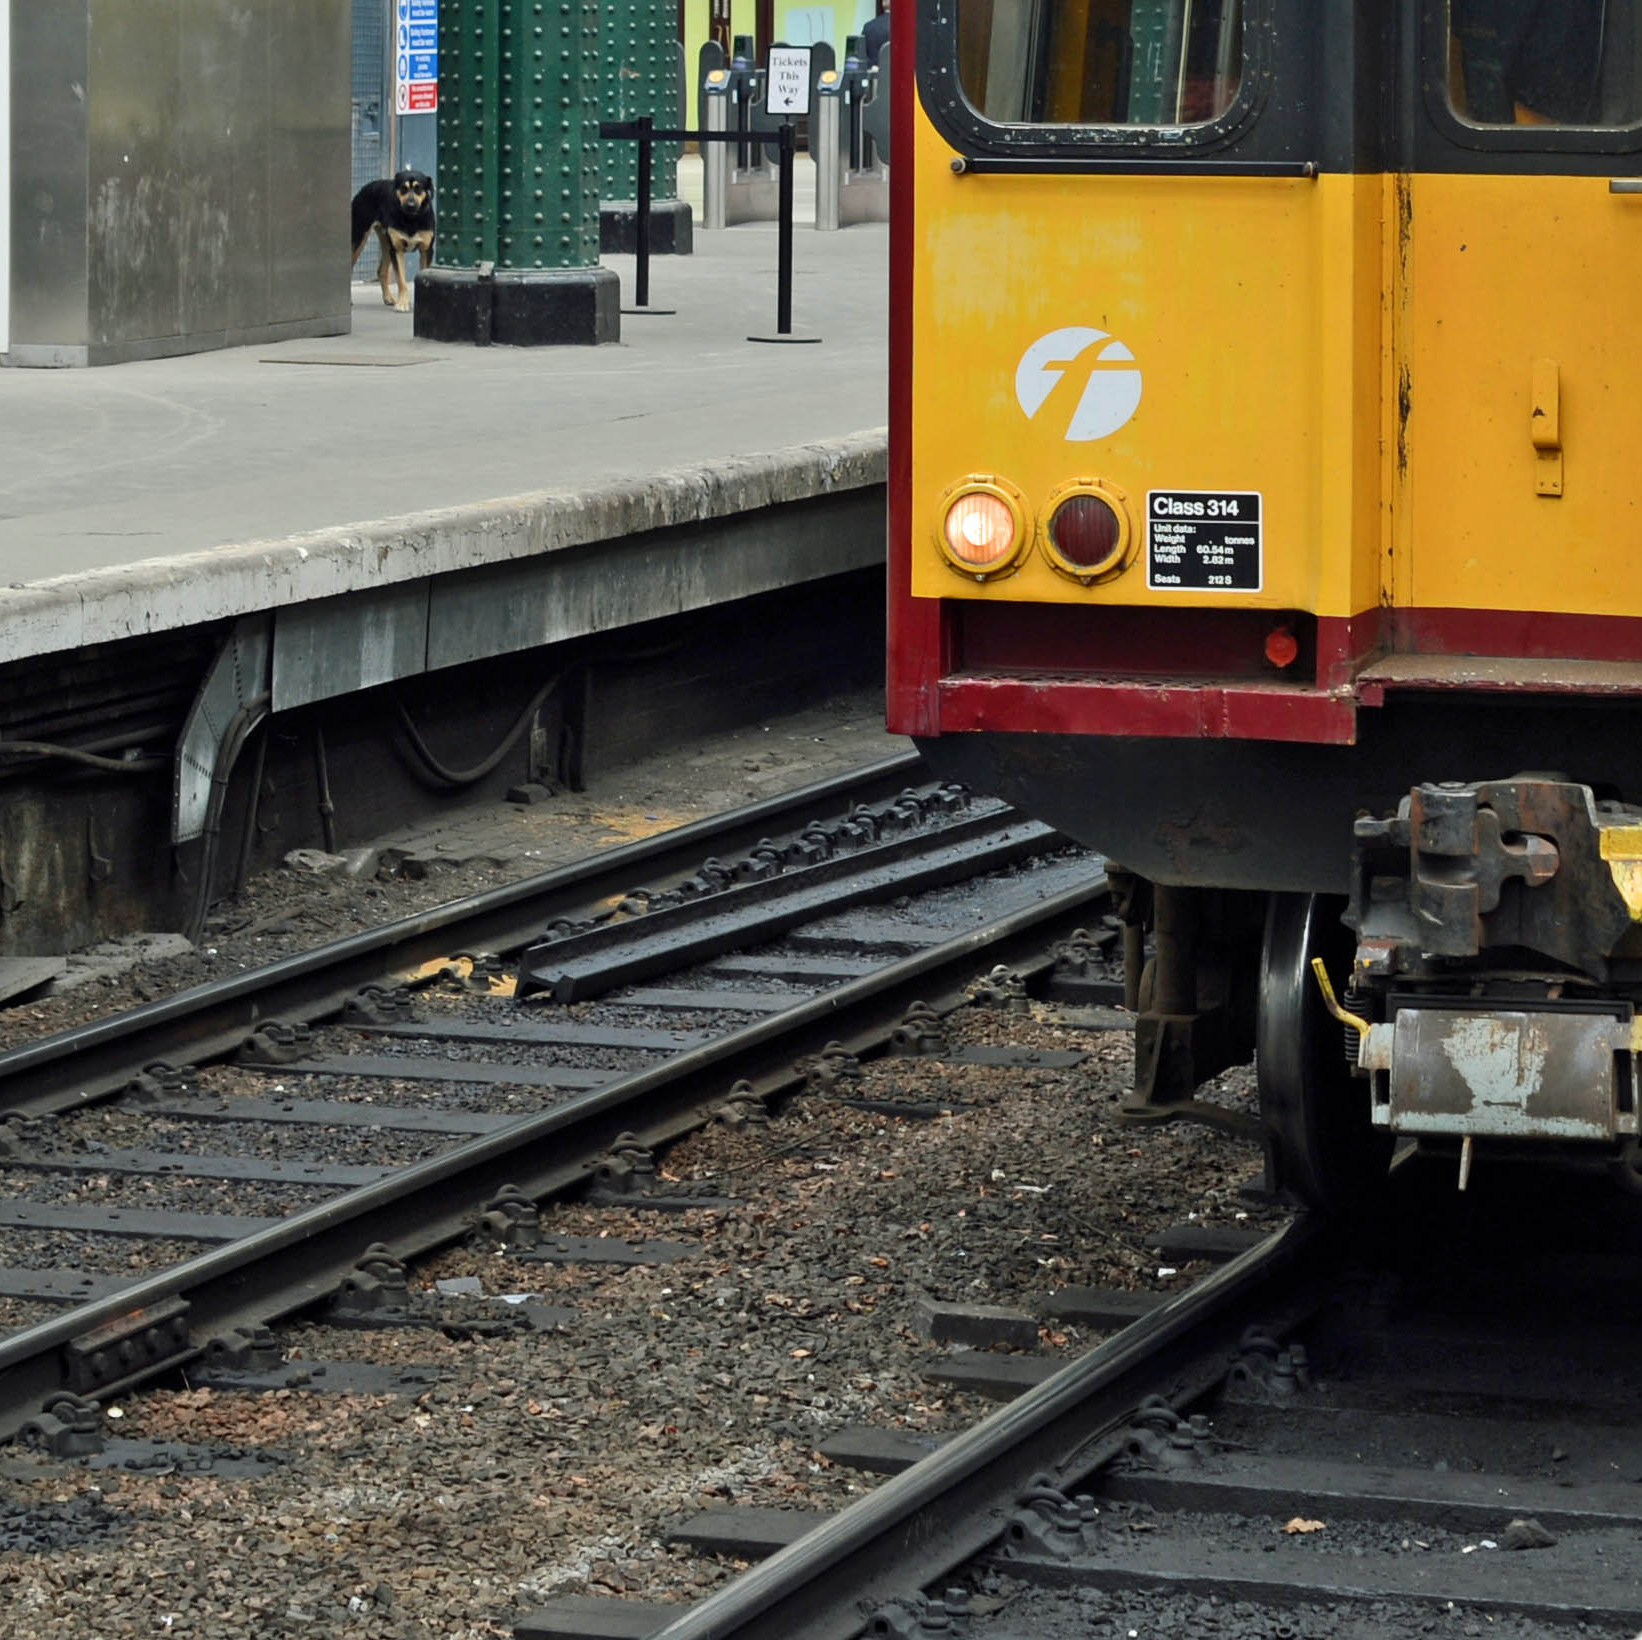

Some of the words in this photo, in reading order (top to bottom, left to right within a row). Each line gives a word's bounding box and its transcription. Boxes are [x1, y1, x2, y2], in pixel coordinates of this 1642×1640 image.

[772, 56, 808, 67] Tickets
[780, 71, 800, 81] This
[778, 84, 799, 96] Way
[1153, 497, 1205, 516] Class
[1206, 498, 1240, 517] 314
[1153, 523, 1172, 533] Unit
[1172, 524, 1197, 534] data:
[1154, 534, 1186, 544] Weight
[1224, 535, 1255, 545] tonnes
[1153, 544, 1187, 555] Length
[1154, 554, 1181, 564] Width
[1154, 573, 1181, 584] Seats
